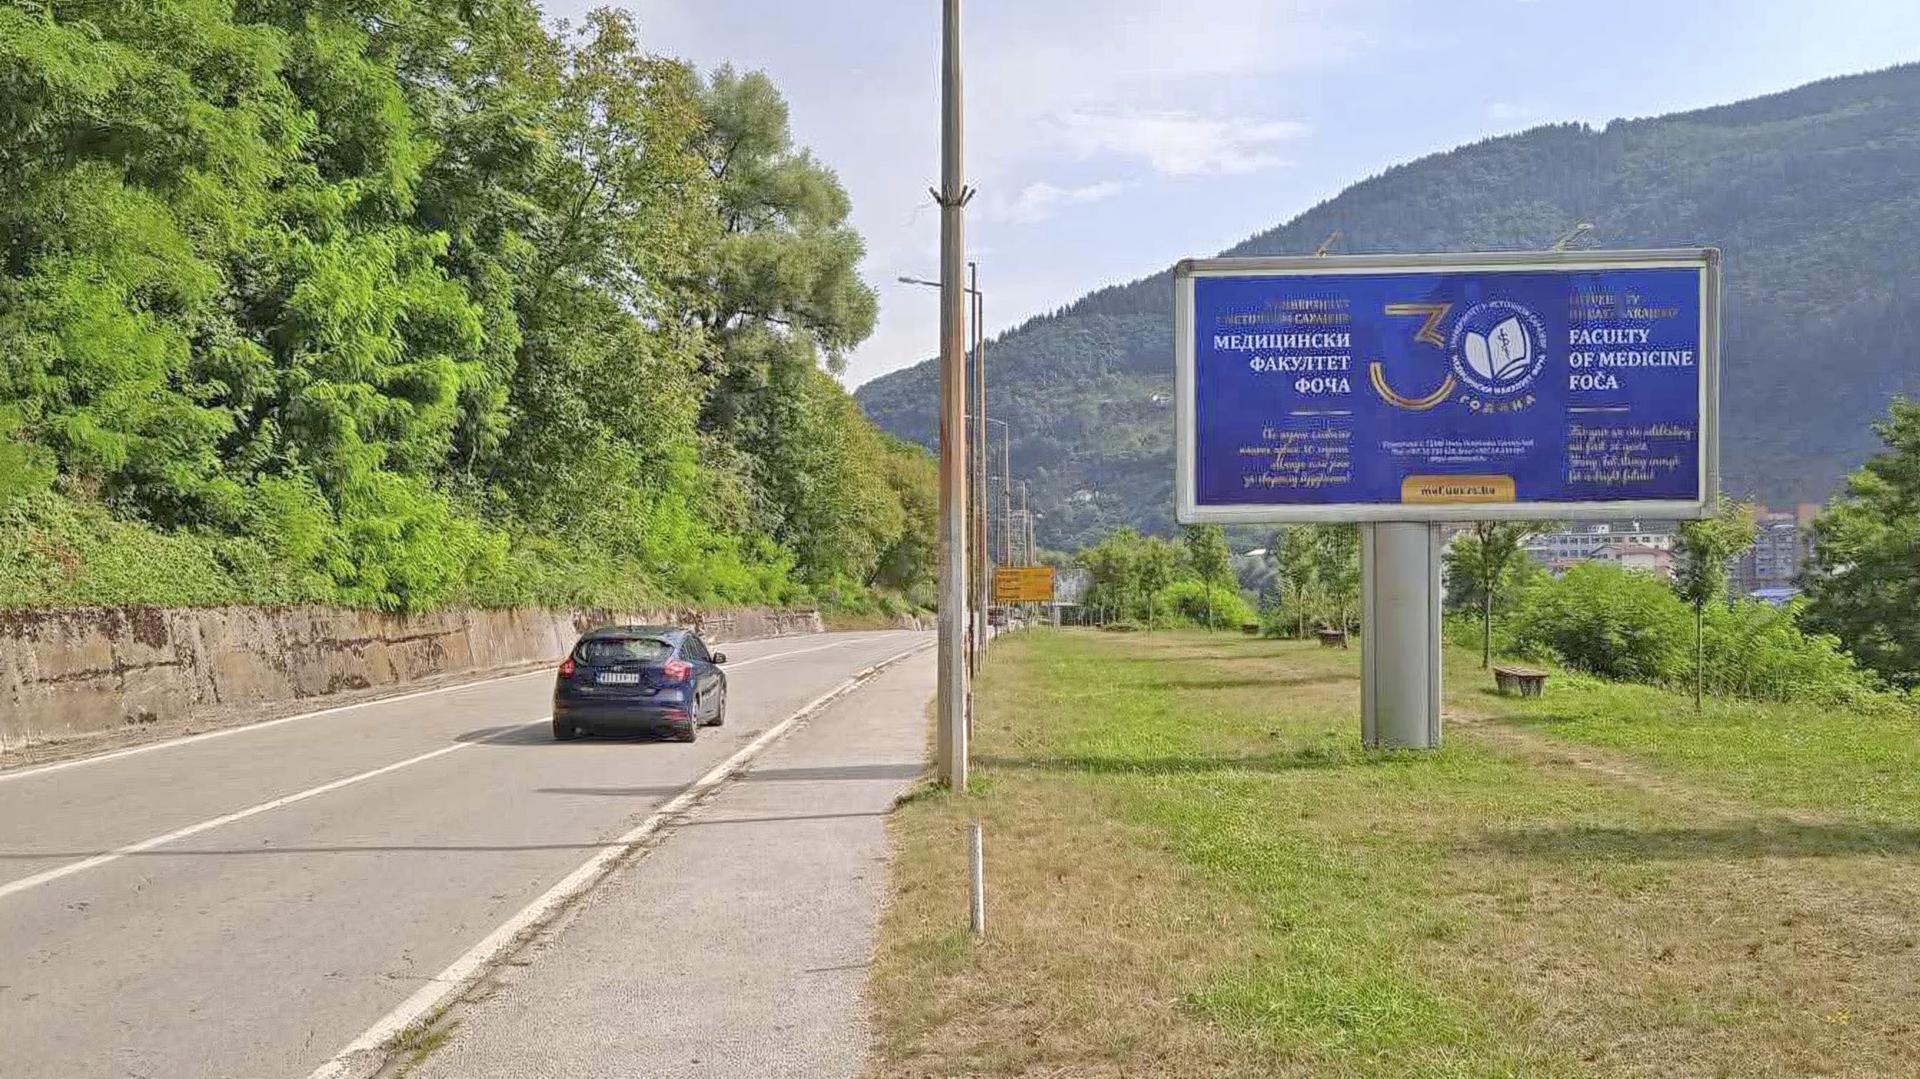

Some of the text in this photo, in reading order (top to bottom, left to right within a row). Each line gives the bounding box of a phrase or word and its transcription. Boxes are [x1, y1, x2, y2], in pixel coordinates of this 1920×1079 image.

[1213, 333, 1351, 352] МЕДИЦИНСКИ
[1569, 328, 1650, 345] FACULTY
[1249, 355, 1351, 372] ФАКУЛТЕТ
[1569, 351, 1693, 368] OF MEDICINE
[1295, 377, 1351, 394] ФОЧА
[1569, 370, 1619, 390] FOČA
